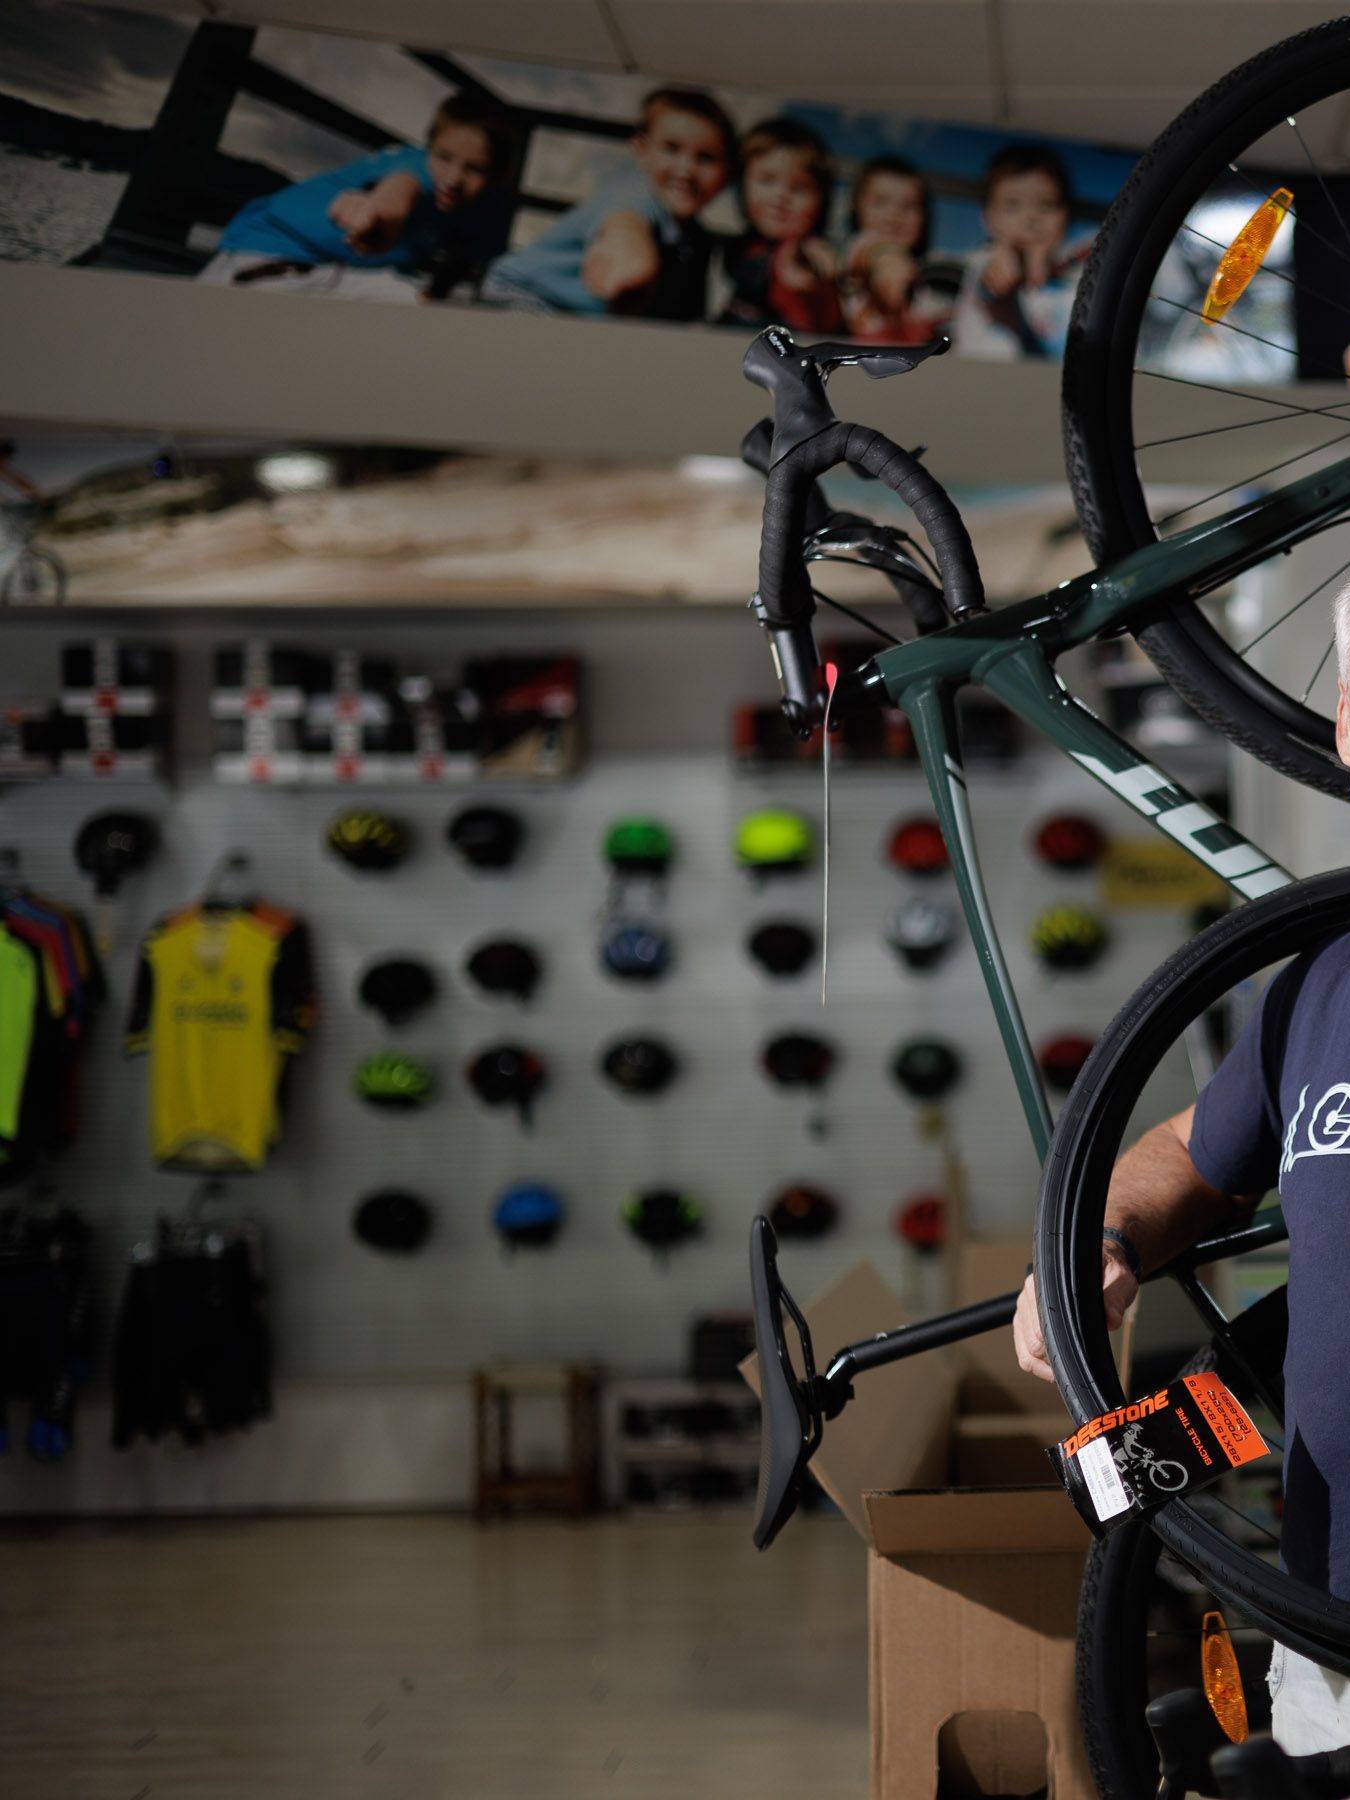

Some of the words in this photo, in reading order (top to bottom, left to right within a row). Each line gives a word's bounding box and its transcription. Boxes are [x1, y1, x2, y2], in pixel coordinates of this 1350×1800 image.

[1063, 1388, 1169, 1458] DEESTONE
[1174, 1407, 1191, 1429] TIRE
[1187, 1427, 1213, 1466] BICYCLE
